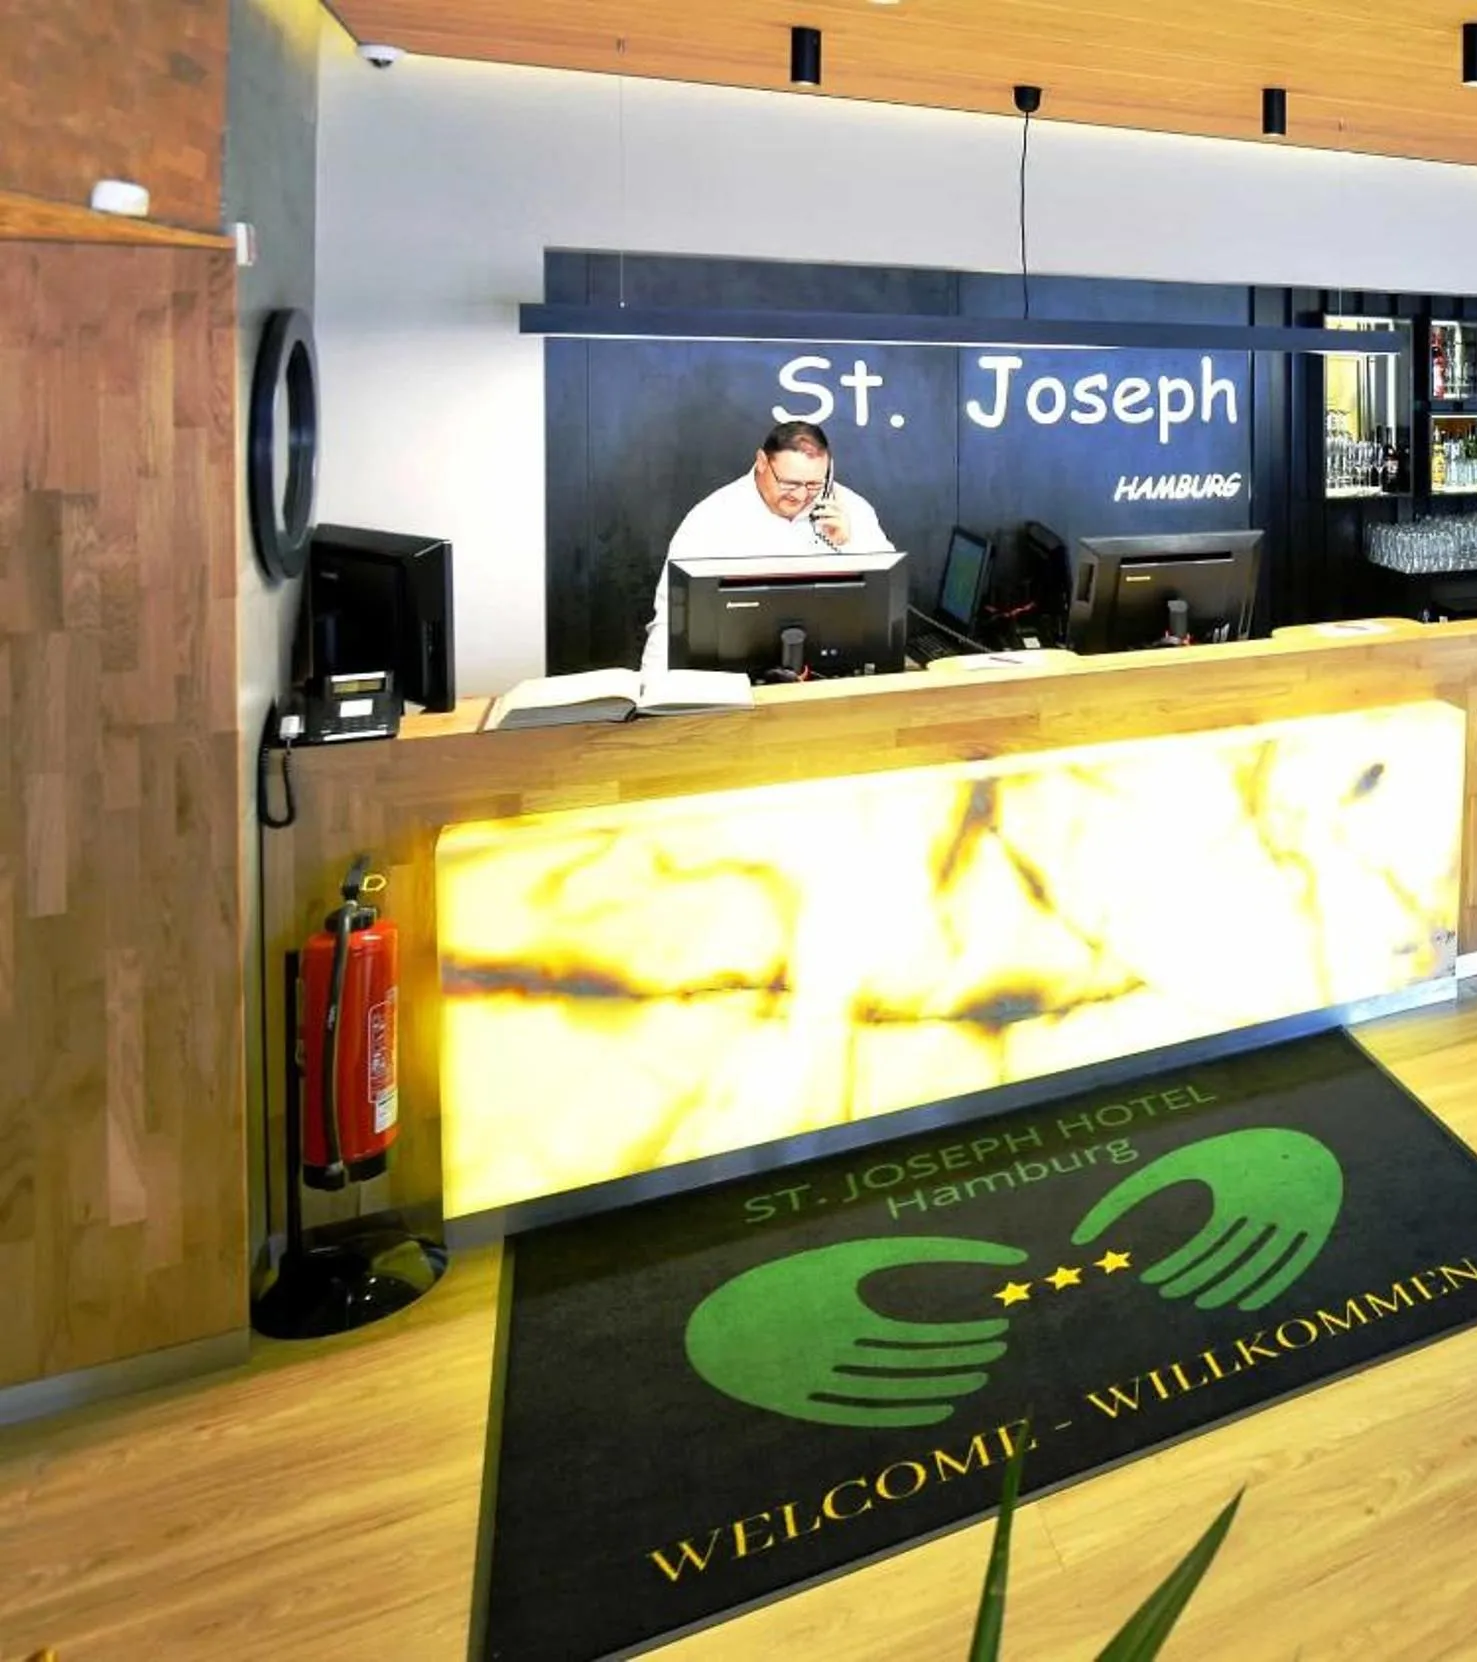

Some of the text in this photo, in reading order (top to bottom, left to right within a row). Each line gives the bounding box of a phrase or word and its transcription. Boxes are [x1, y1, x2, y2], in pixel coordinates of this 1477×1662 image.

[771, 355, 1238, 444] St. Joseph
[1114, 472, 1241, 502] HAMBURG
[743, 1084, 1218, 1224] ST. JOSEPH HOTEL
[887, 1134, 1139, 1220] Hamburg
[646, 1419, 1038, 1583] WELCOME
